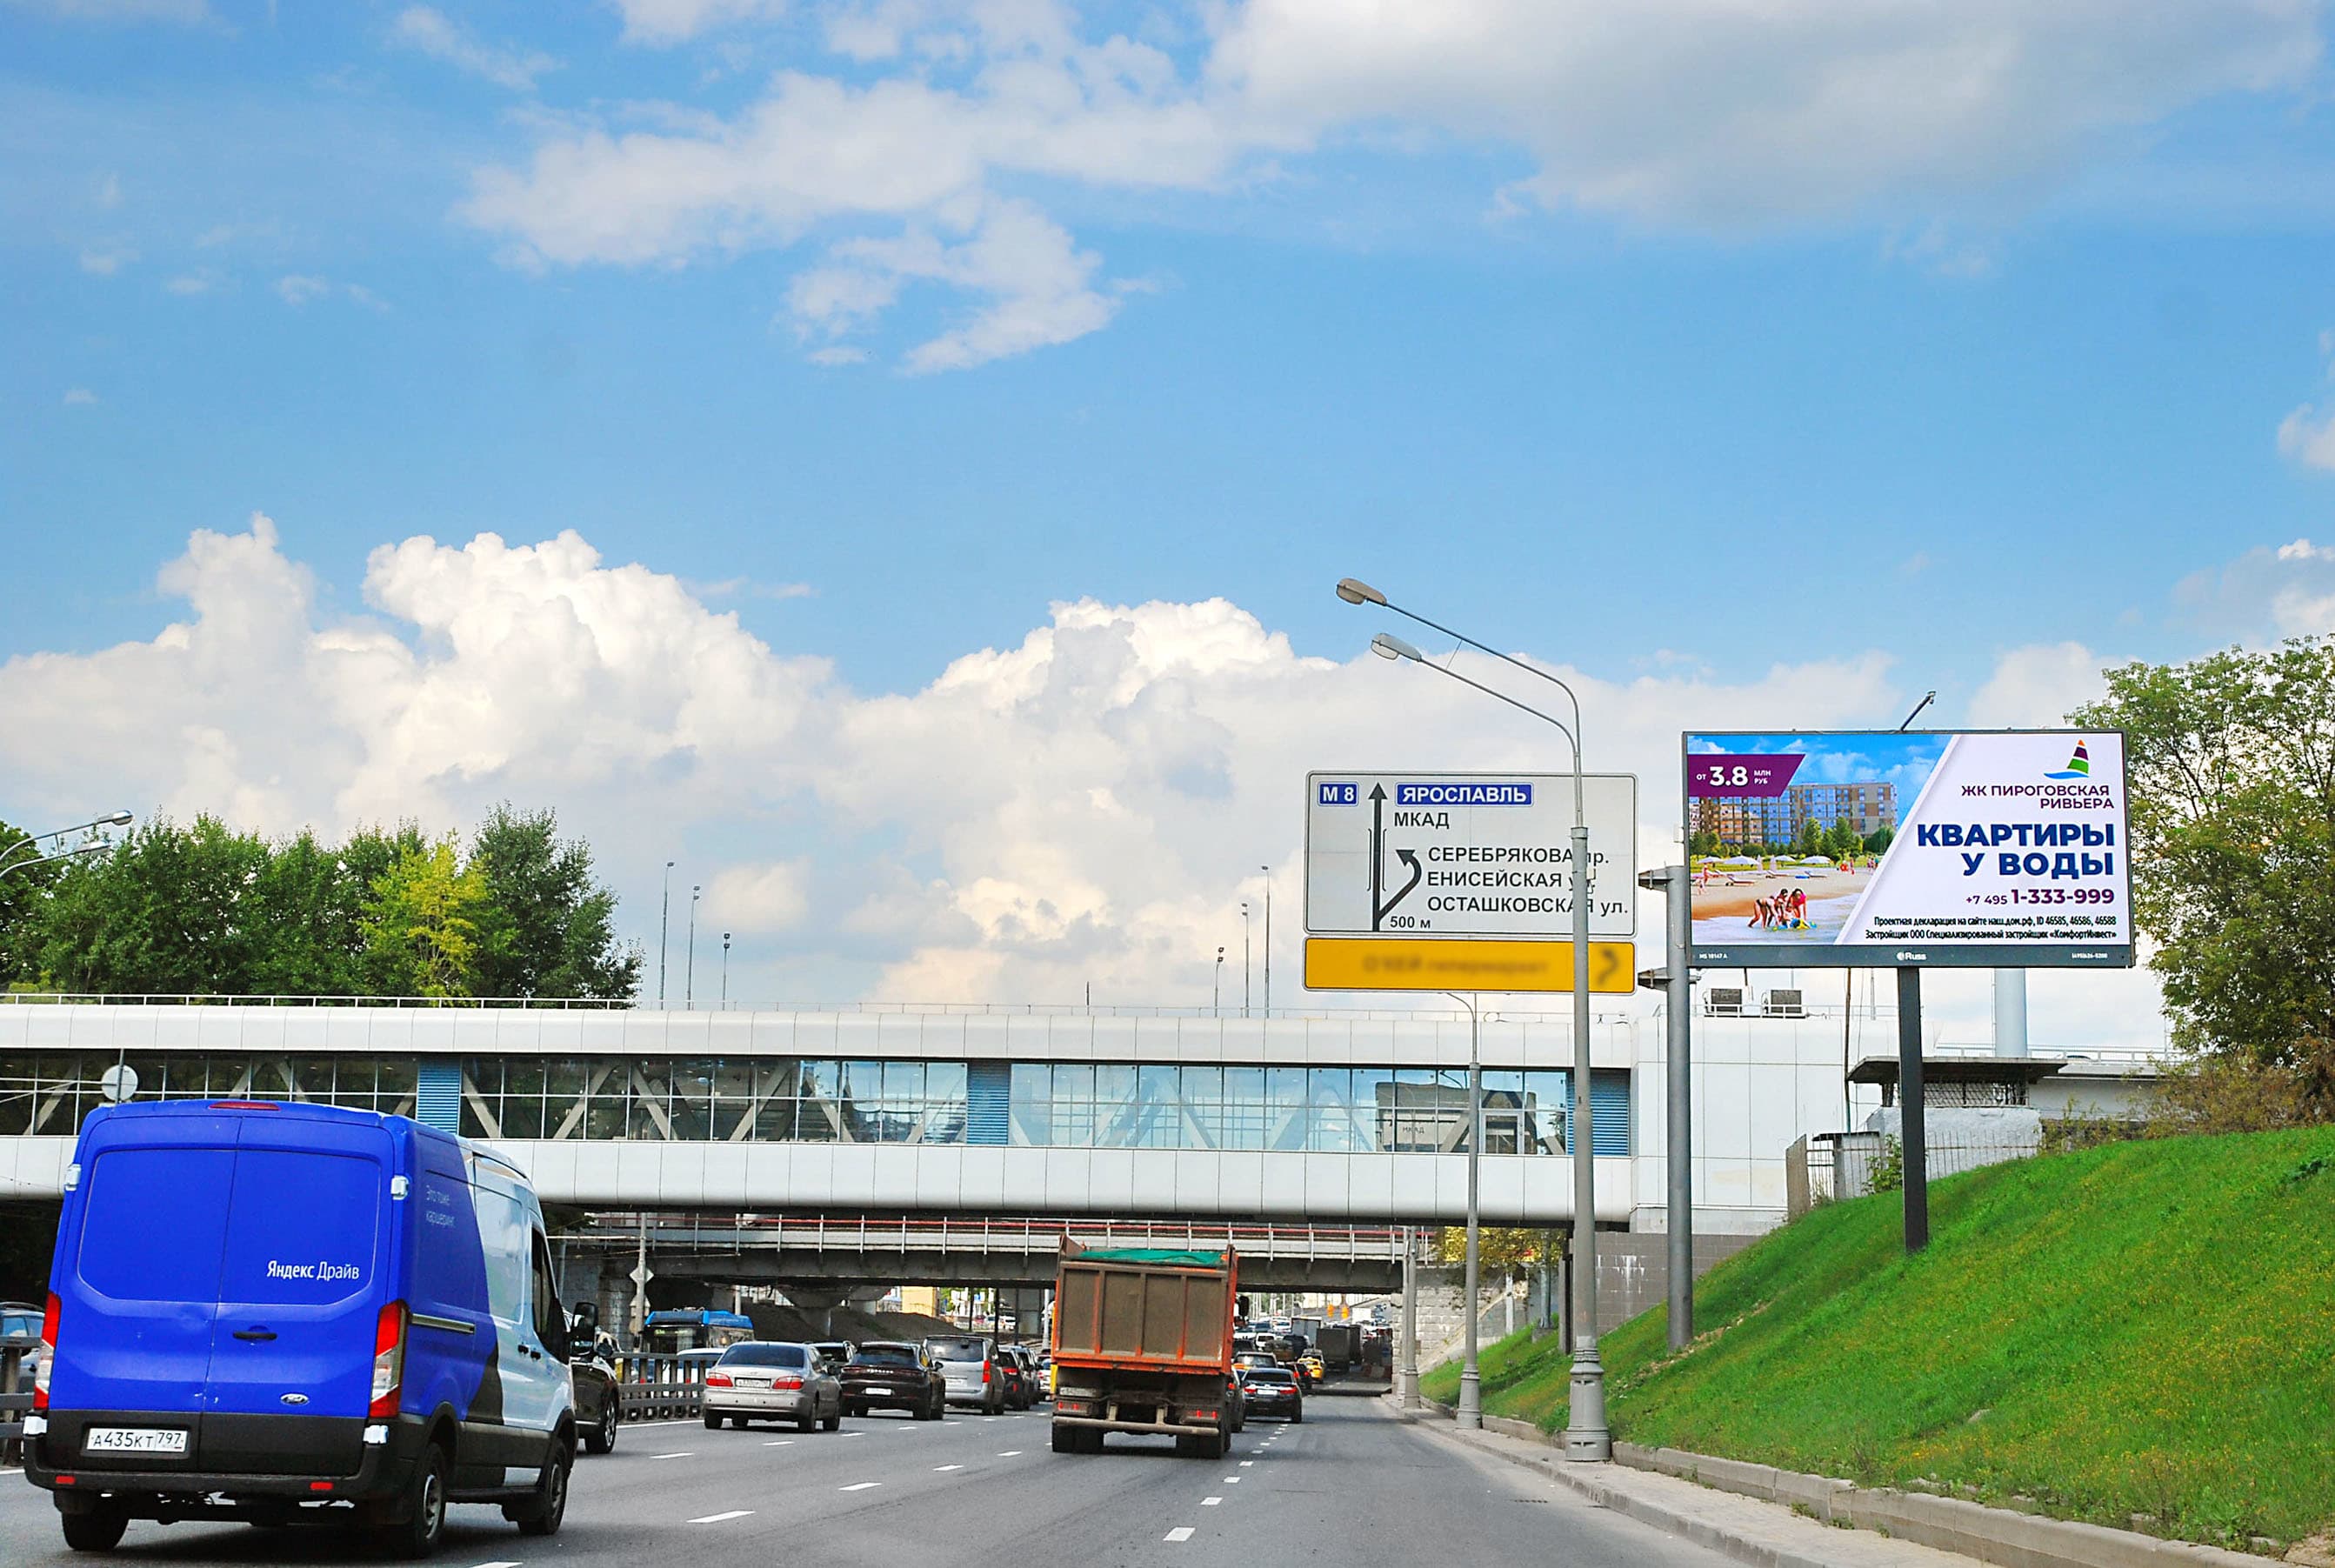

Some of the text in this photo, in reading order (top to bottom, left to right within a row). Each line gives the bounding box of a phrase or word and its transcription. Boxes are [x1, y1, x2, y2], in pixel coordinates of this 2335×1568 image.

[1709, 765, 1749, 786] 3.8
[1402, 787, 1527, 803] ЯРОСЛАВЛЬ
[1961, 784, 2110, 797] ЖК ПИРОГОВСКАЯ
[2040, 797, 2115, 809] РИВЬЕРА
[1393, 811, 1450, 830] МКАД
[1917, 824, 2115, 847] КВАРТИРЫ
[1428, 847, 1573, 863] СЕРЕБРЯКОВА
[1960, 852, 2115, 881] У ВОДЫ
[1427, 869, 1562, 887] ЕНИСЕЙСКАЯ
[1965, 889, 2115, 904] +7 495 1-333-999
[1600, 902, 1628, 917] ул.
[1390, 916, 1431, 929] 500 м
[1874, 916, 1912, 926] Проектная
[1913, 917, 1956, 926] декларация
[1967, 917, 1987, 925] сайте
[2036, 916, 2045, 925] ID
[1865, 929, 1909, 939] Застройщик
[1910, 929, 1925, 938] ООО
[266, 1260, 360, 1282] Яндекс Драйв
